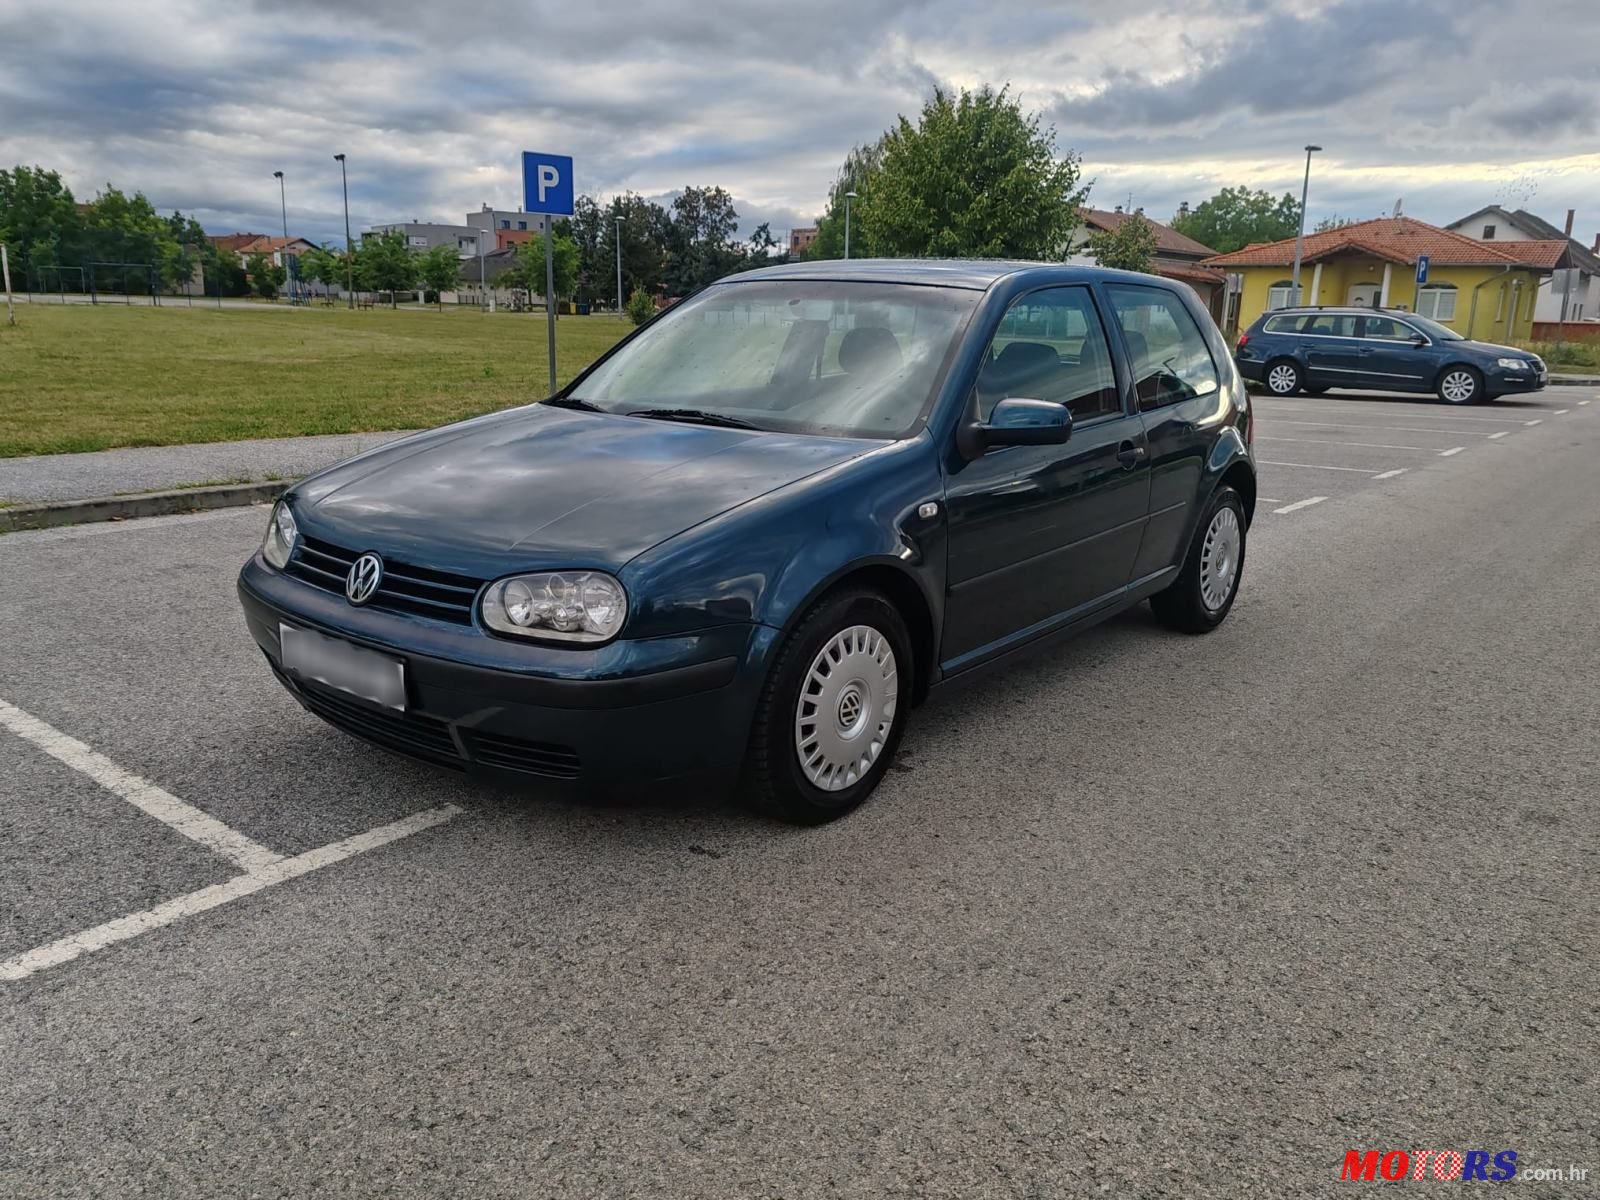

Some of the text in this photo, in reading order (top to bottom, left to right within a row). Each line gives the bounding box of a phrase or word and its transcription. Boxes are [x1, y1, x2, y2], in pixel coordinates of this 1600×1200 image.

[537, 164, 560, 202] P
[1418, 260, 1426, 279] P
[346, 555, 380, 602] VW
